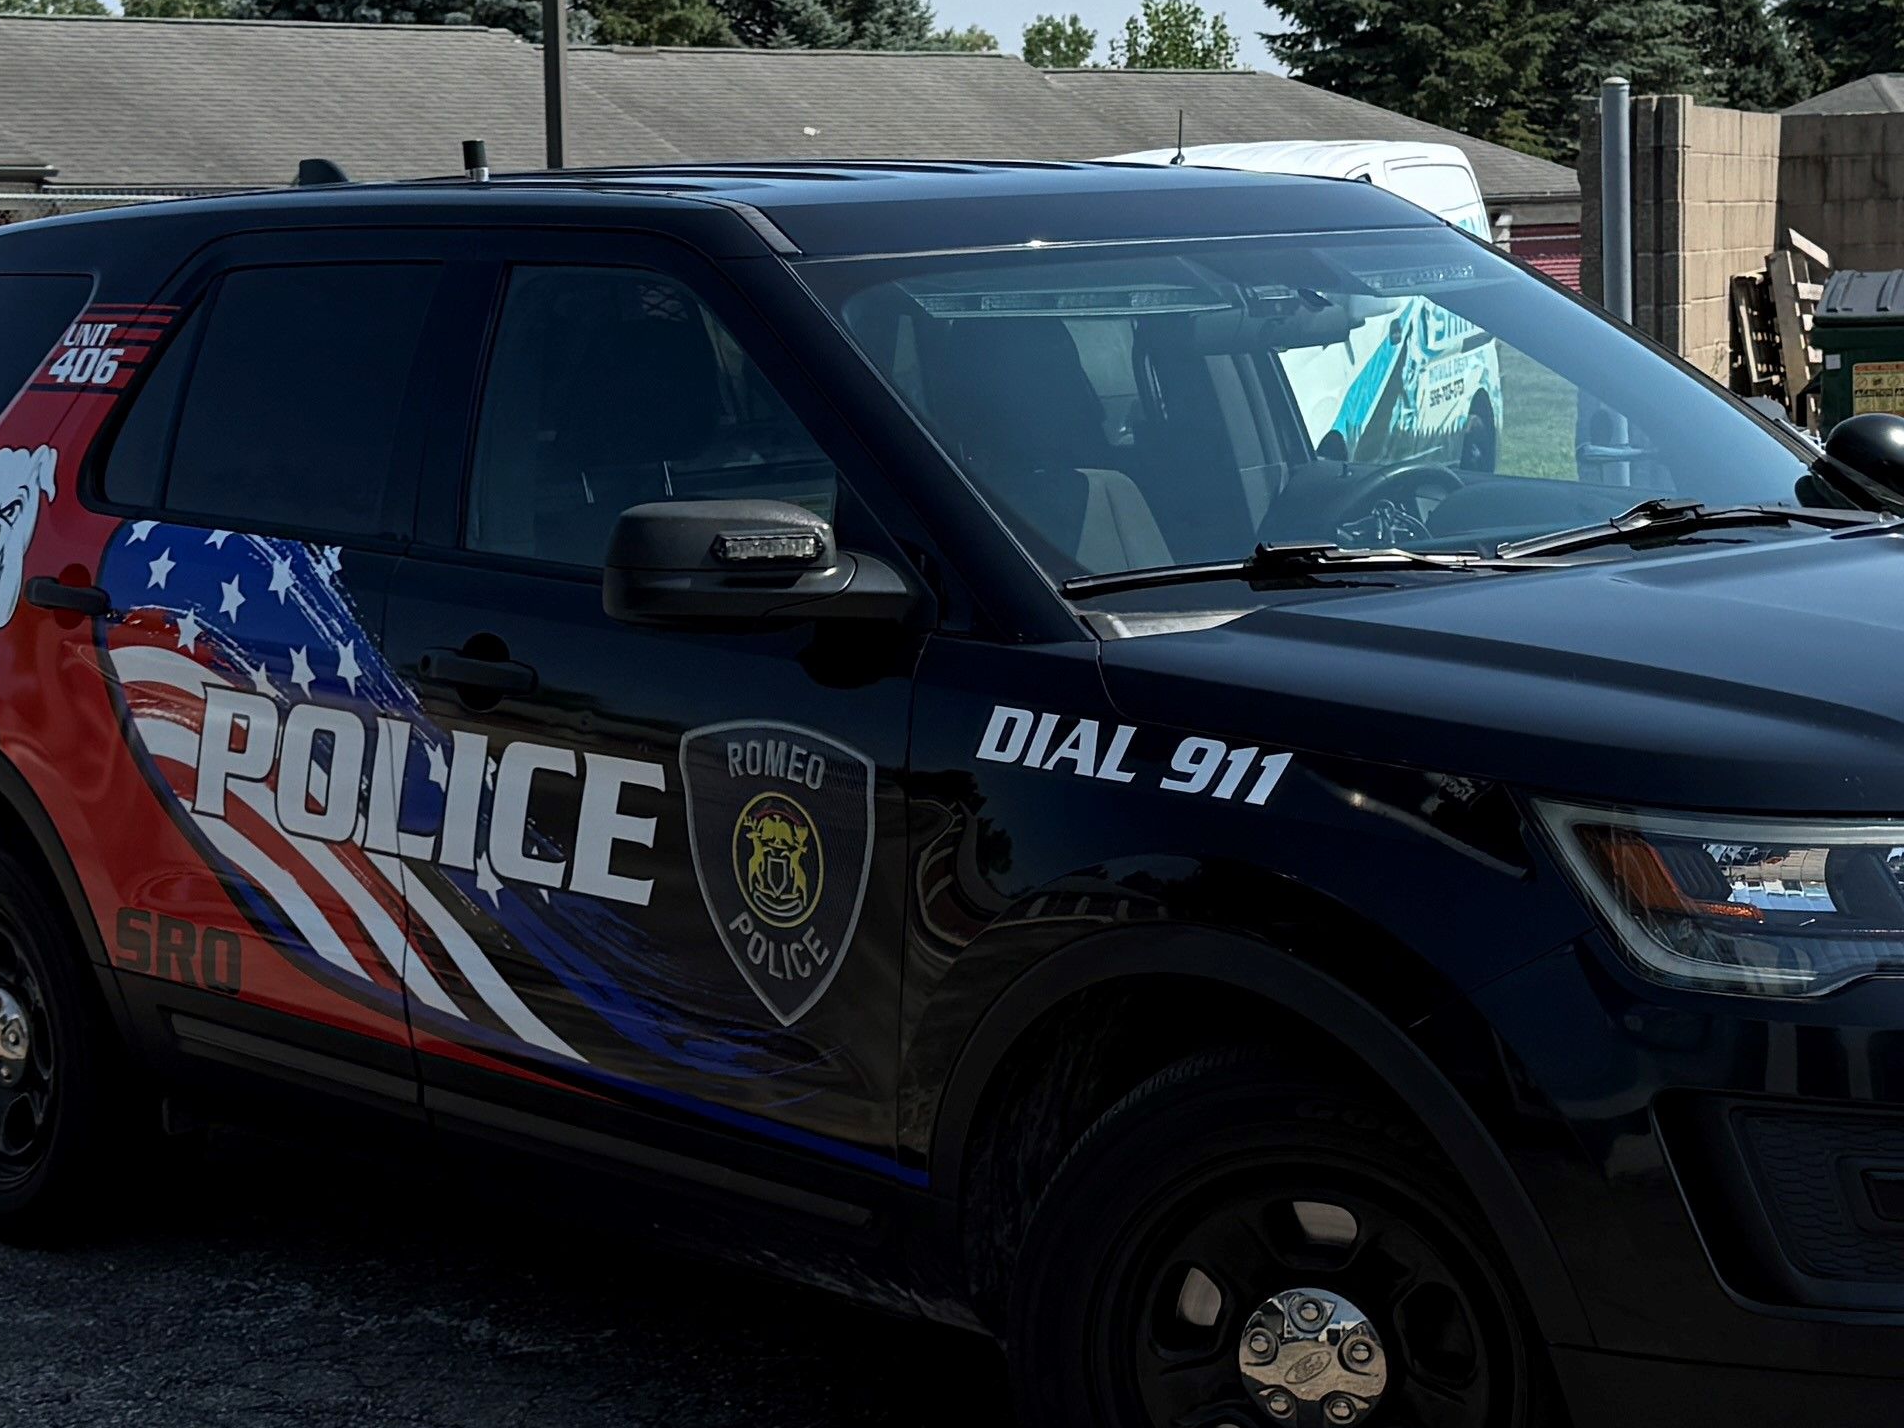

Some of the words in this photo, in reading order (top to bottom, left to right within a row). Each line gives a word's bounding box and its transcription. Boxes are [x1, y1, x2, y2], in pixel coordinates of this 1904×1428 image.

[48, 348, 125, 384] 406
[63, 323, 118, 347] UNIT
[727, 739, 826, 791] ROMEO
[976, 705, 1137, 783] DIAL
[1160, 736, 1293, 806] 911
[192, 686, 667, 906] POLICE
[115, 907, 242, 996] SRO
[729, 913, 829, 981] POLICE
